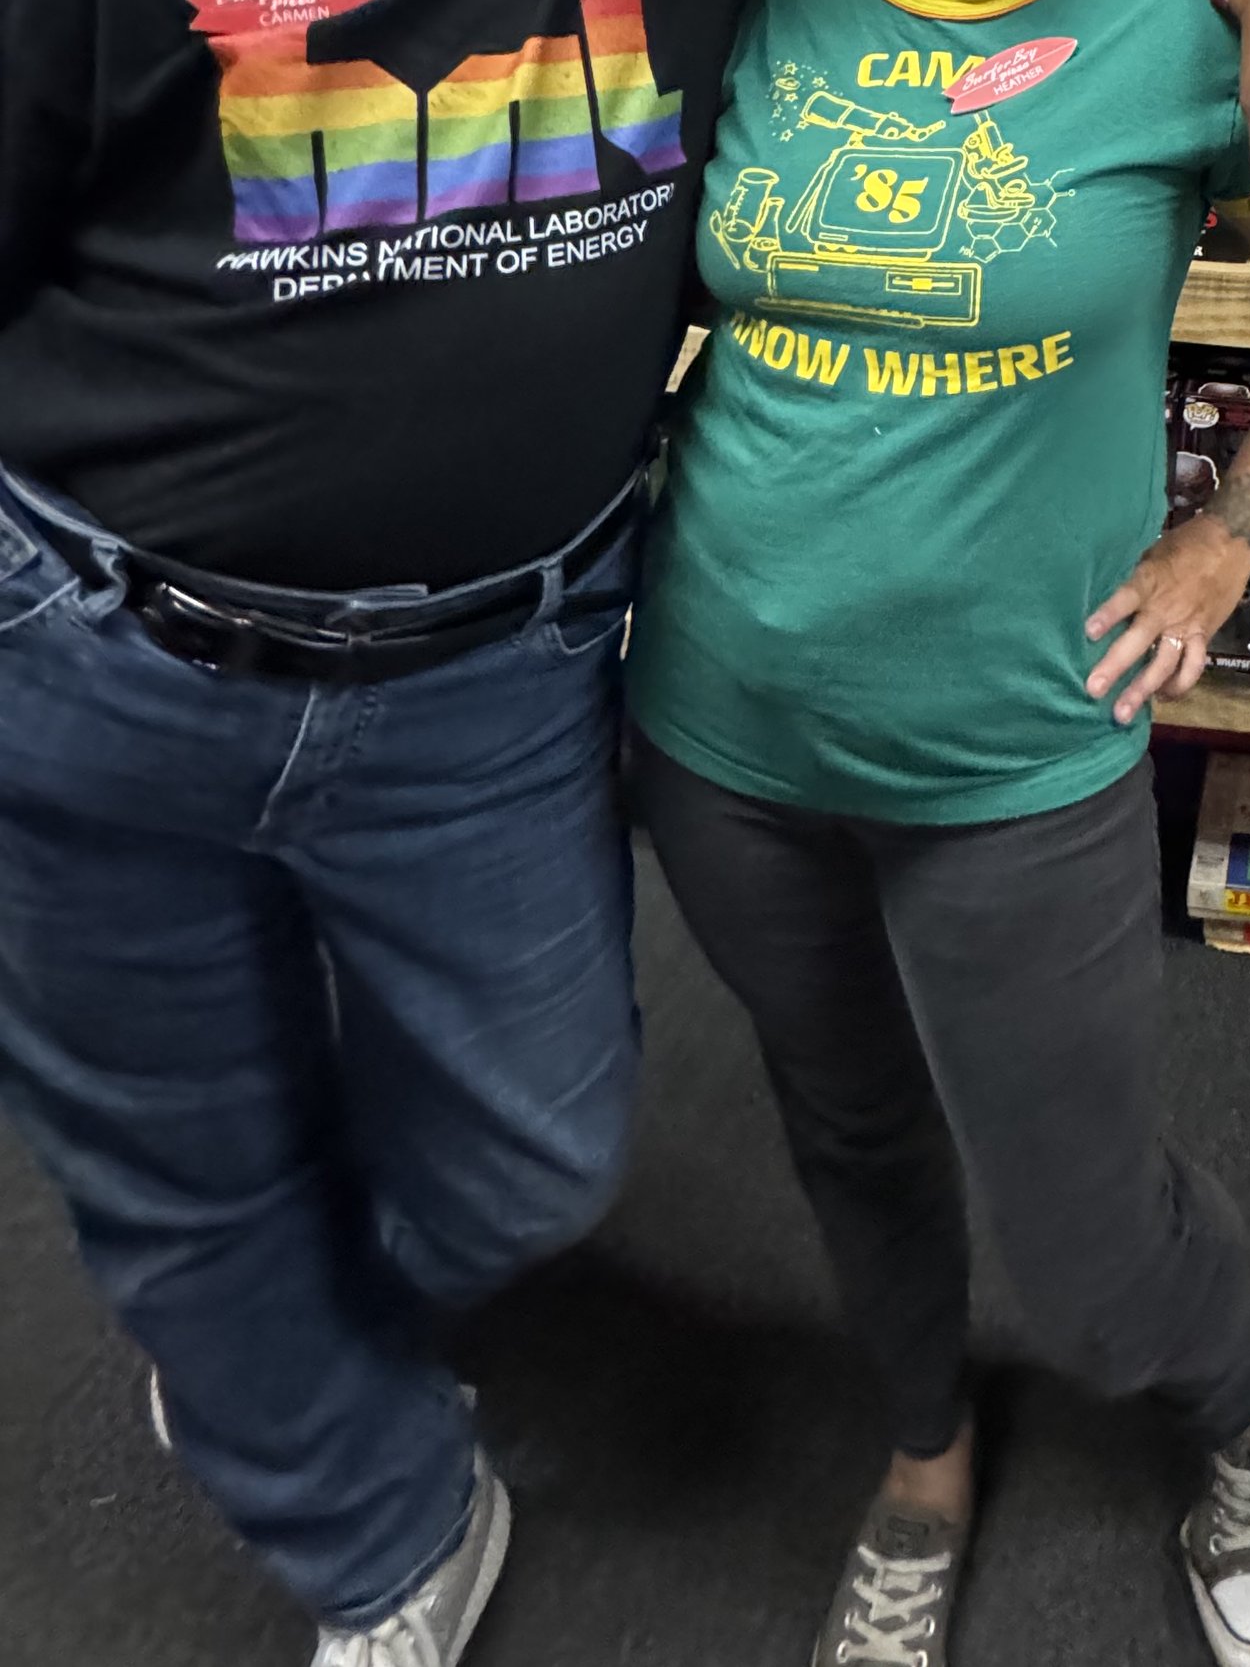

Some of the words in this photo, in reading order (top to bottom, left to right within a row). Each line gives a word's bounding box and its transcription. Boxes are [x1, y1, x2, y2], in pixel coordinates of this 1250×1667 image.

[259, 5, 330, 27] CARMEN
[993, 65, 1044, 96] HEATHER
[215, 240, 368, 272] HAWKINS
[272, 252, 487, 303] DEPTMENT
[496, 249, 538, 274] OF
[547, 219, 648, 268] ENERGY
[863, 330, 1075, 398] WHERE
